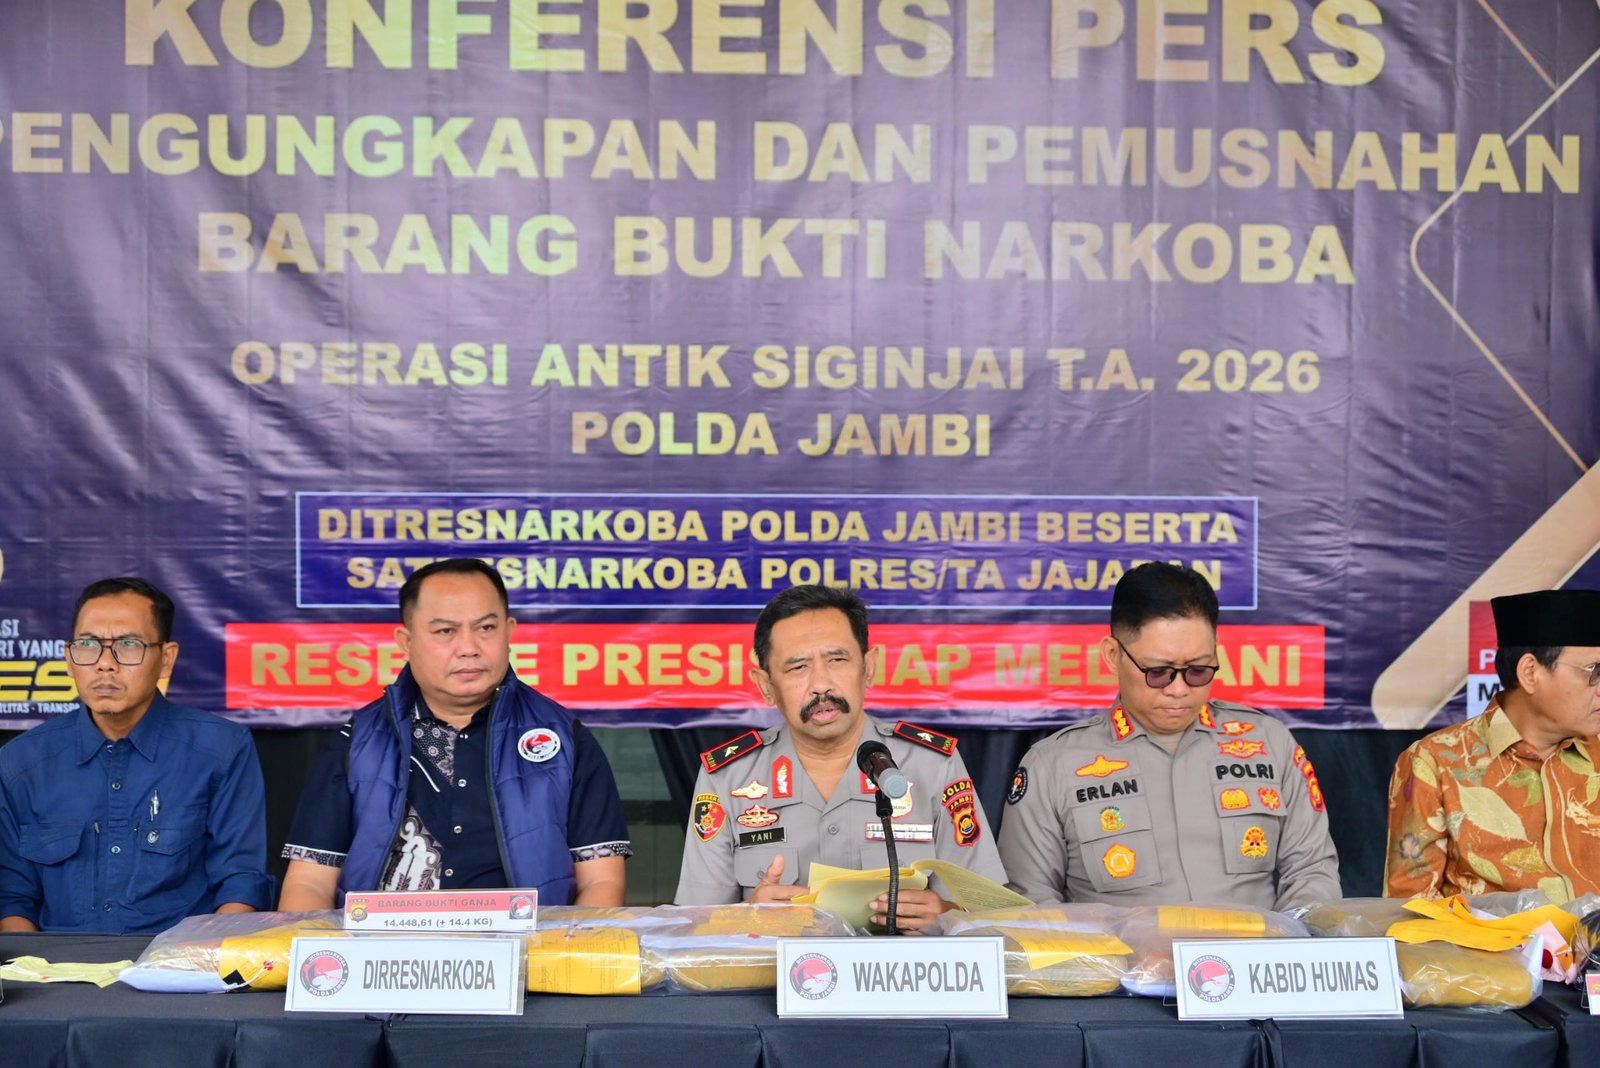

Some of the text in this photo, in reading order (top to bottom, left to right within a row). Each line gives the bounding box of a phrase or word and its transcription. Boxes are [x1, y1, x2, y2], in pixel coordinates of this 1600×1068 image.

[124, 0, 1386, 86] KONFERENSI PERS
[0, 112, 1580, 194] ENGUNGKAPAN DAN PEMUSNAHAN
[199, 212, 1355, 285] BARANG BUKTI NARKOBA
[231, 341, 1321, 393] OPERASI ANTIK SIGINJAI T.A. 2026
[571, 411, 991, 457] POLDA JAMBI
[317, 508, 1238, 543] DITRESNARKOBA POLDA JAMBI BESERTA
[347, 556, 1222, 591] SASNARKOBA POLRES/TA JAJAN
[0, 619, 20, 638] SI
[19, 640, 65, 660] YANG
[251, 642, 1300, 687] RESEE PRESI IAP MELANI
[1216, 763, 1274, 780] POLRI
[942, 781, 971, 803] POLDA
[950, 795, 972, 810] JAMBI
[1076, 779, 1138, 803] ERLAN
[751, 832, 772, 842] YANI
[378, 899, 421, 908] BARANG
[425, 899, 457, 907] BUKTI
[461, 898, 497, 906] GANJA
[384, 918, 432, 928] 14.448,61
[449, 918, 471, 927] 14.4
[474, 917, 493, 927] KG)
[364, 960, 495, 990] DIRRESNARKOBA
[853, 961, 983, 992] WAKAPOLDA
[1249, 960, 1379, 993] KABID HUMAS
